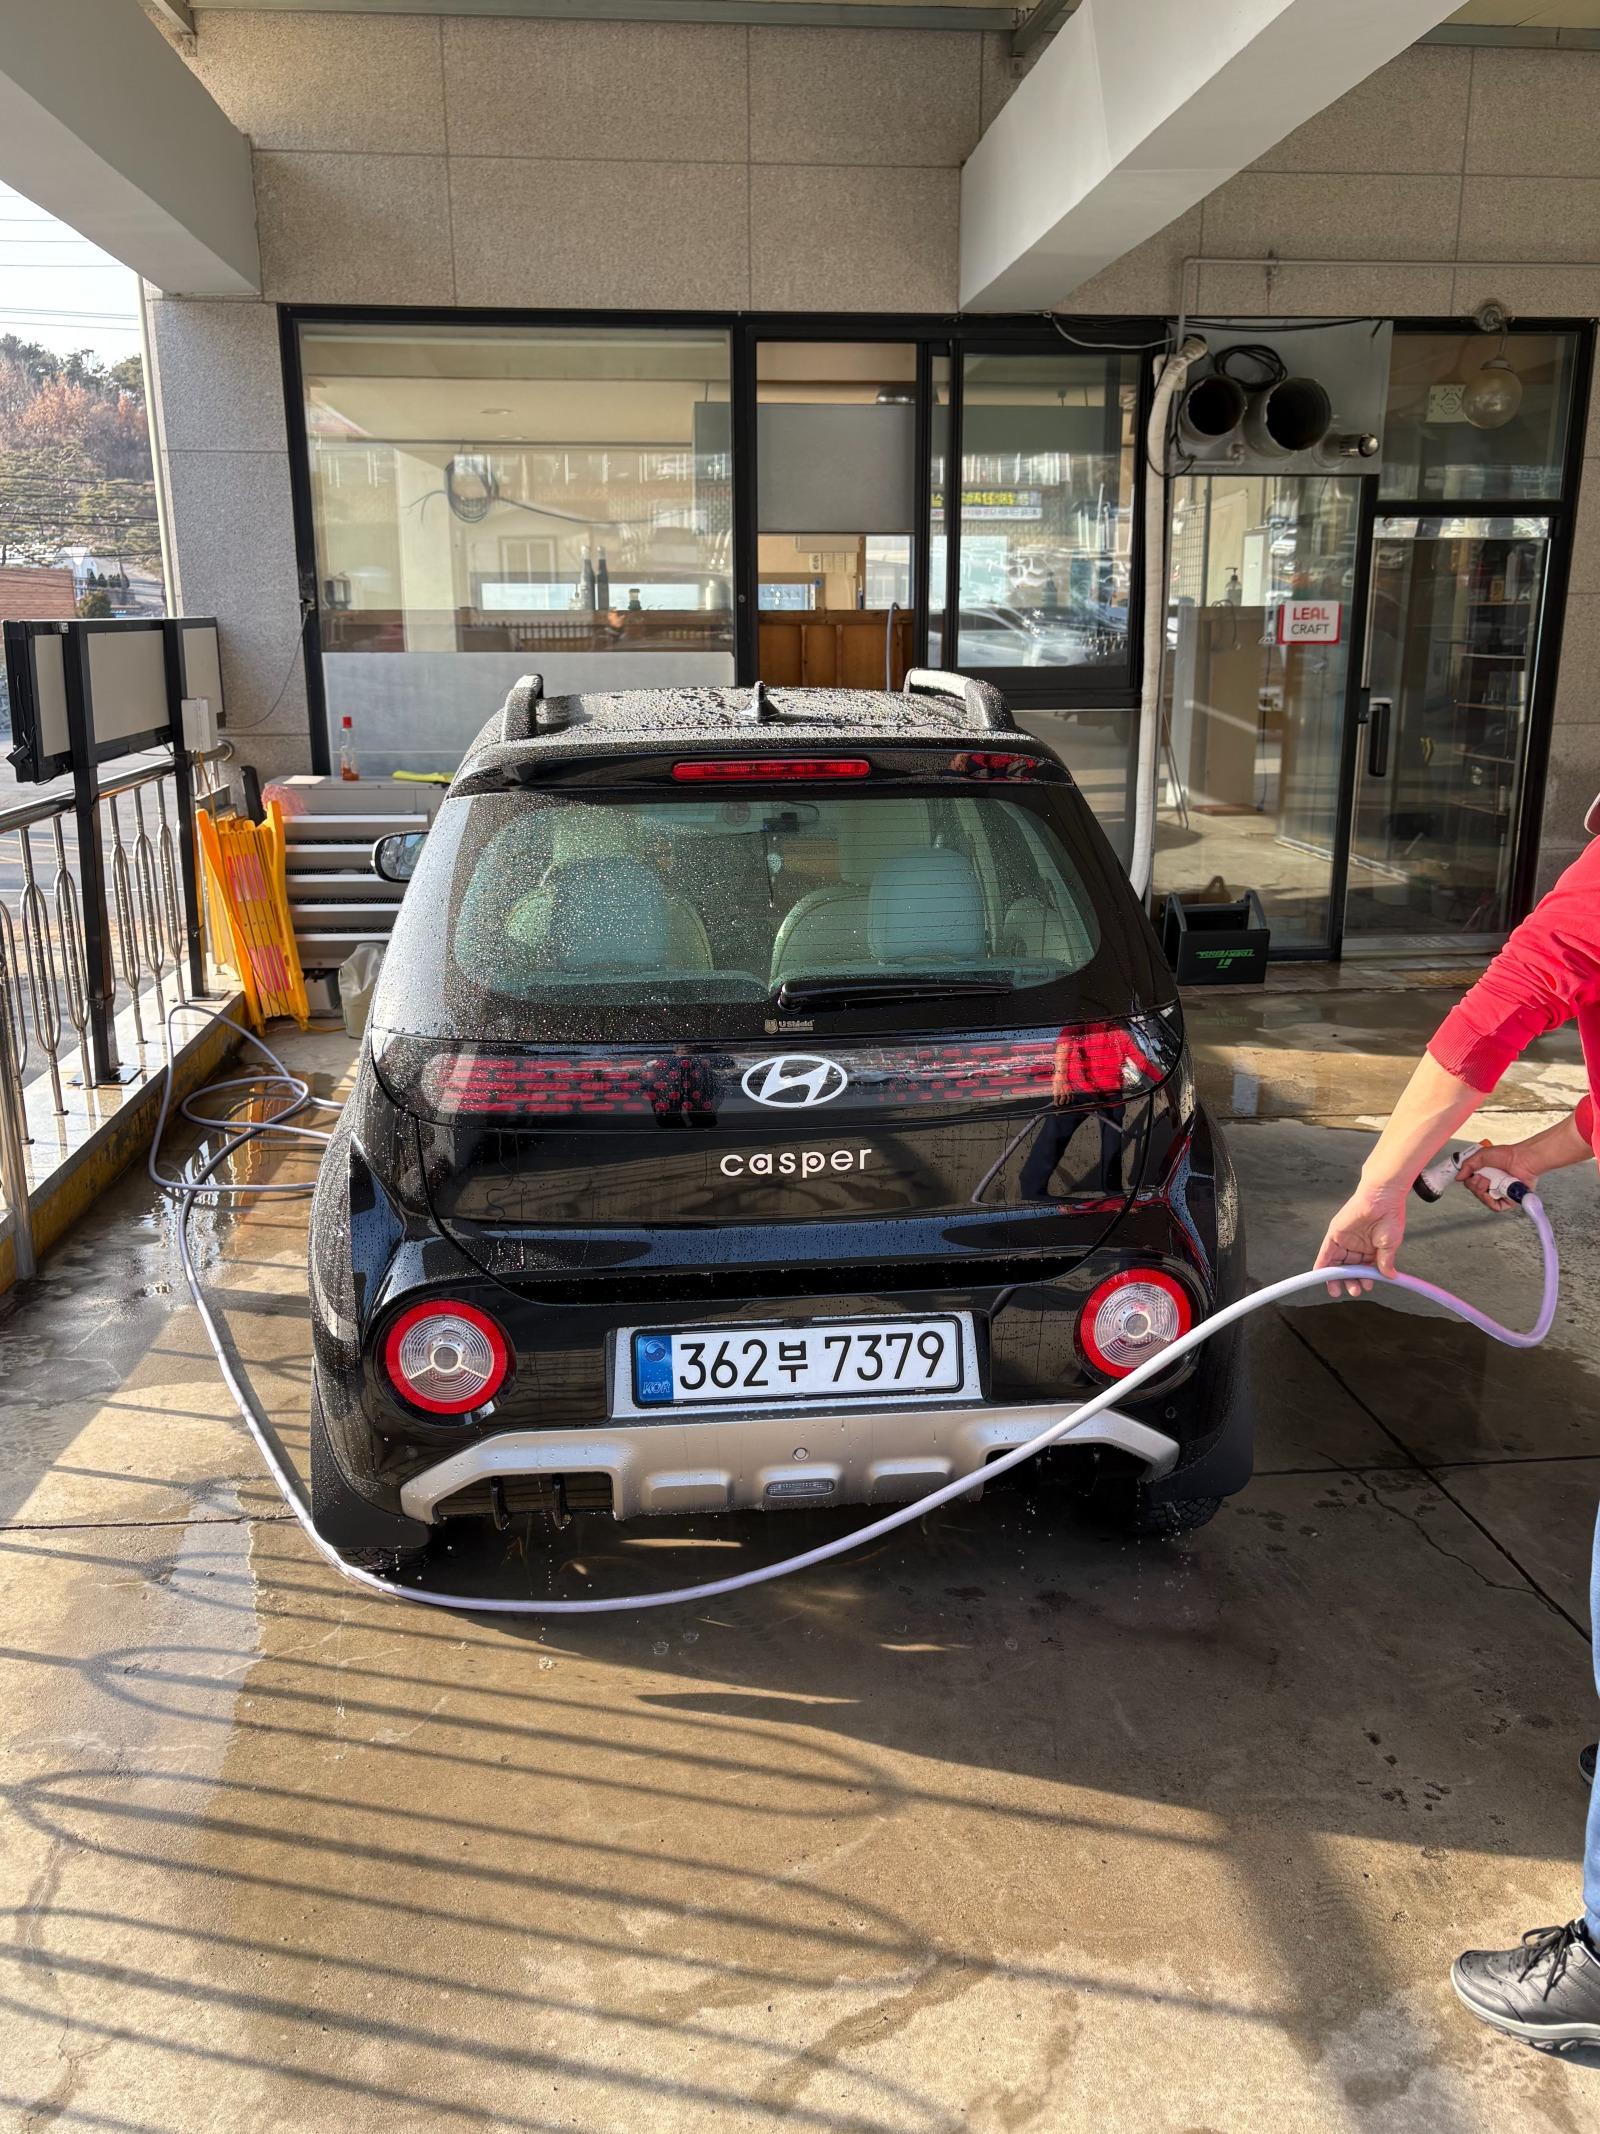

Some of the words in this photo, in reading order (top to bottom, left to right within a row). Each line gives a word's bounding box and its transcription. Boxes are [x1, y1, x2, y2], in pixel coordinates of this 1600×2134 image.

[1292, 607, 1330, 620] LEAL
[1291, 623, 1329, 635] CRAFT
[719, 1148, 872, 1179] casper
[680, 1338, 808, 1391] 362부
[824, 1330, 945, 1383] 7379
[642, 1380, 671, 1394] KOR
